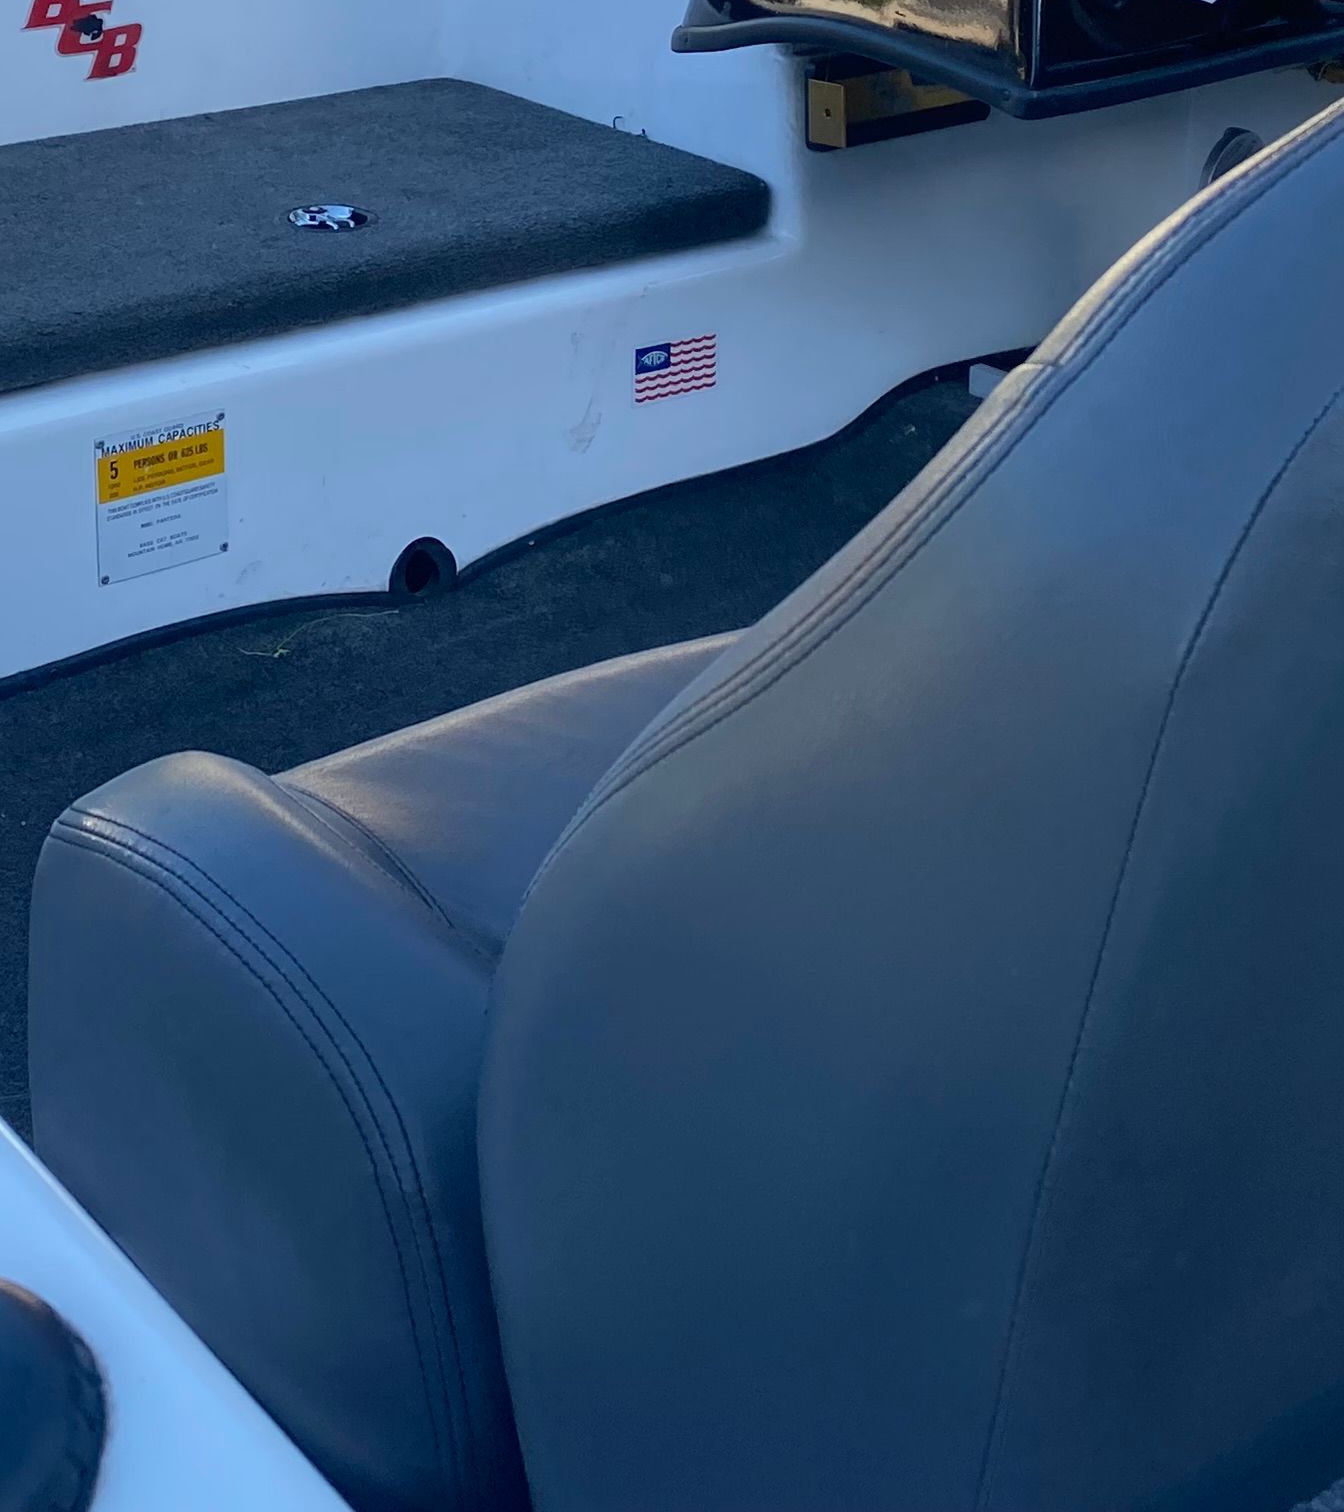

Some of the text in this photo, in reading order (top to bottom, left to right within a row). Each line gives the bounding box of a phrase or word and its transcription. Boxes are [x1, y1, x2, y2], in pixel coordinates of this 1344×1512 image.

[101, 420, 220, 458] MAXIMUM CAPACITIES
[110, 460, 119, 480] 5
[133, 453, 165, 470] PERSONS
